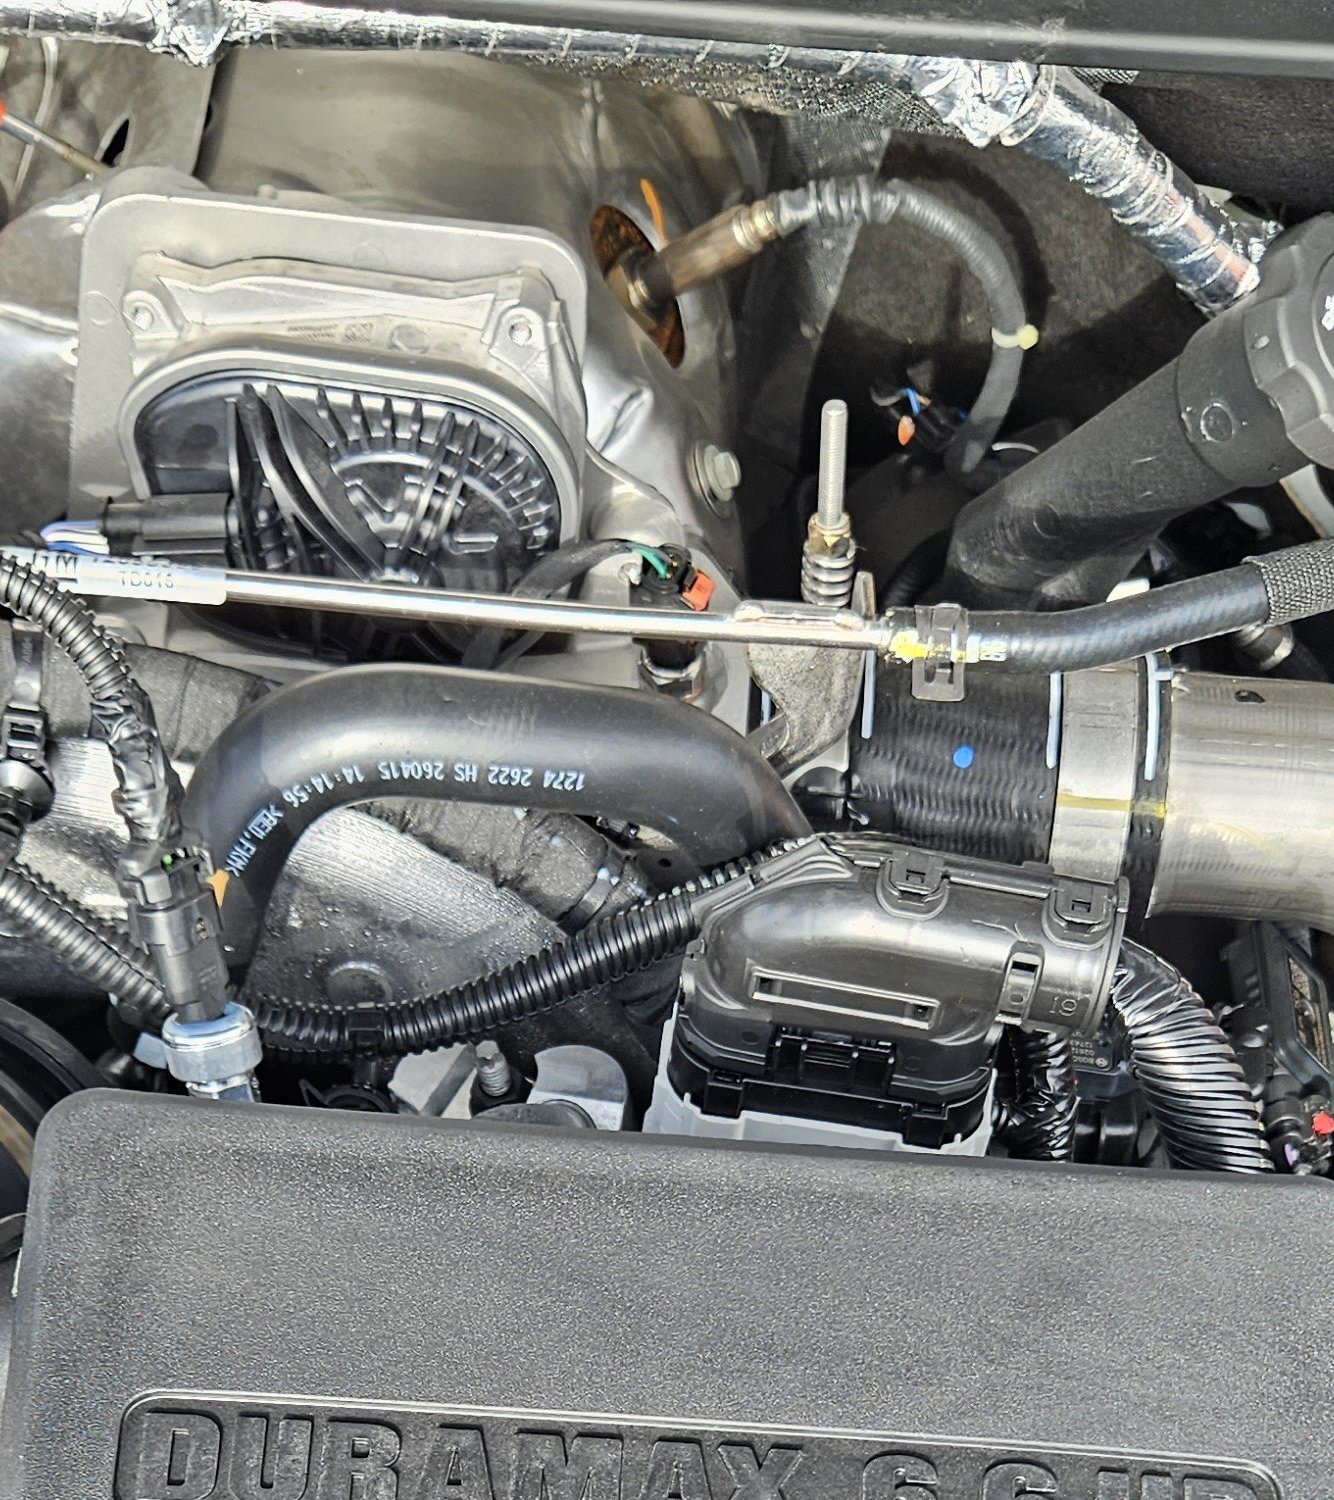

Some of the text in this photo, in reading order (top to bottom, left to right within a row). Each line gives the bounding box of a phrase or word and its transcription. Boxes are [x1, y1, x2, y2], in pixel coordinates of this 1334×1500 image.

[377, 760, 444, 780] 260415
[453, 762, 477, 781] HS
[487, 765, 533, 787] 2622
[542, 768, 585, 790] 1274
[281, 764, 365, 807] 14:14:56
